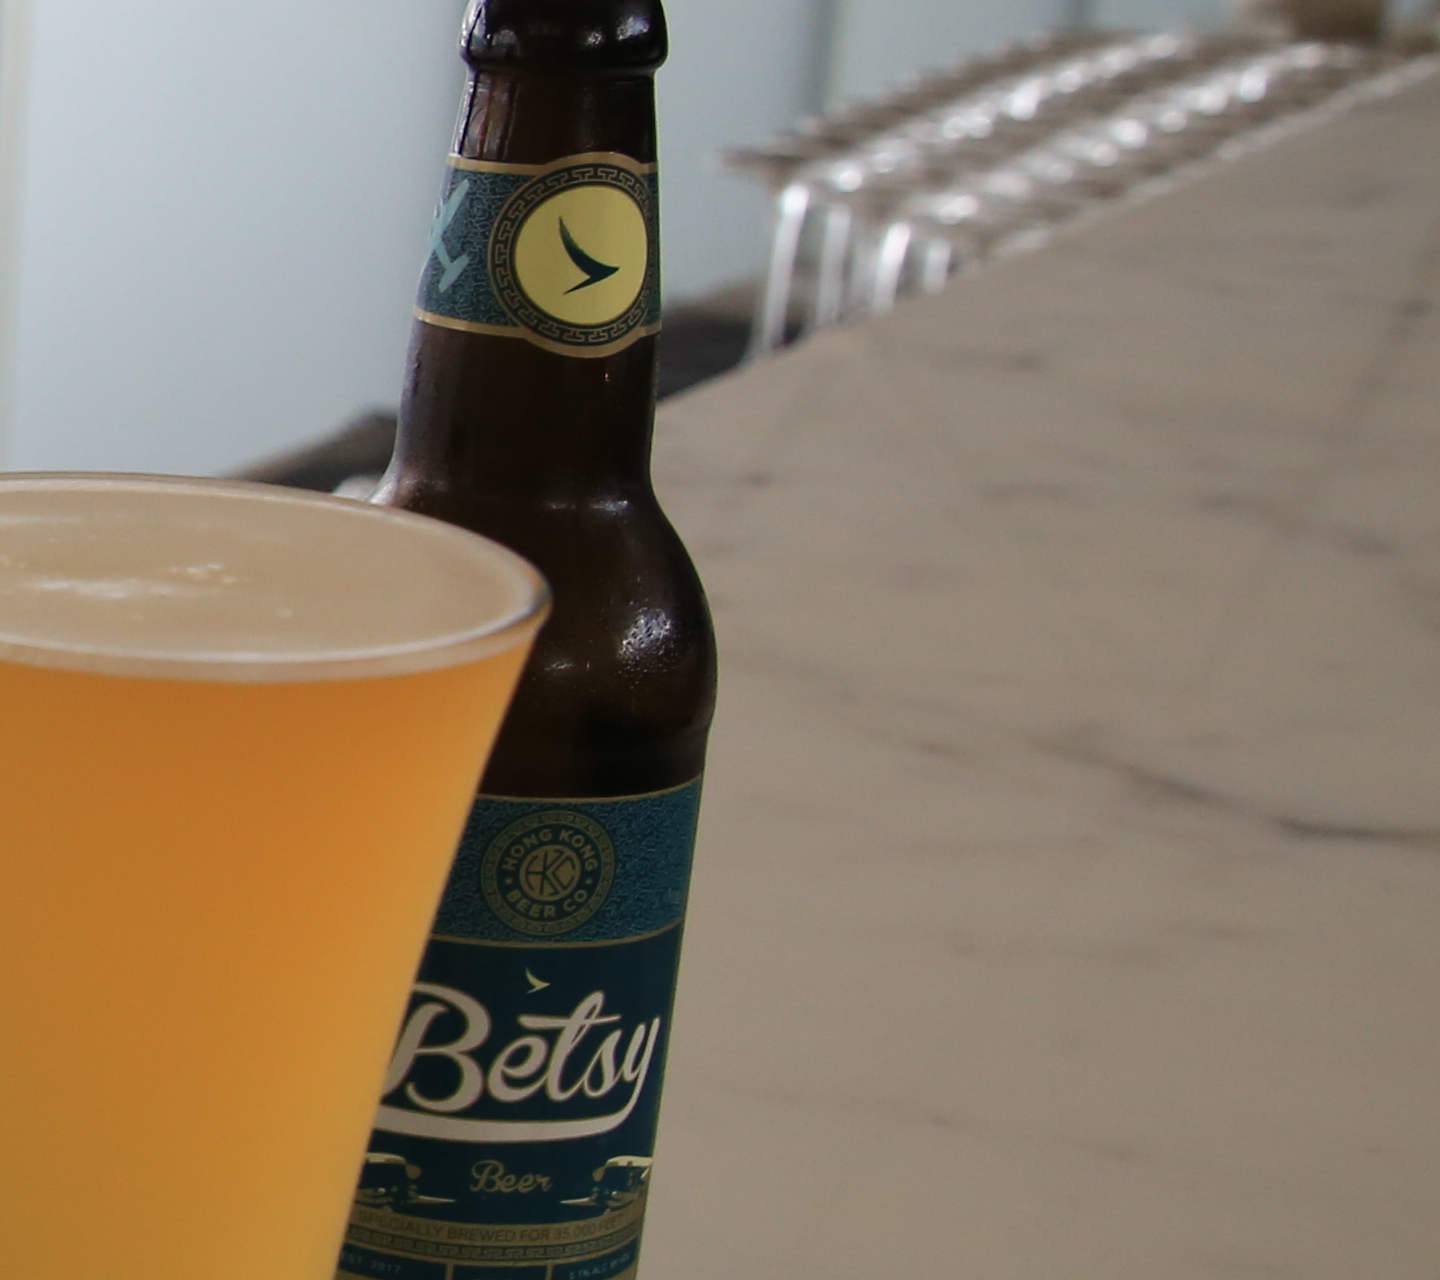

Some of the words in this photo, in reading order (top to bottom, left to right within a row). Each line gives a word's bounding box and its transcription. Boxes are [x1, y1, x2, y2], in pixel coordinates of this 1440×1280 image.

[501, 828, 552, 871] HONG
[559, 828, 599, 871] KONG
[506, 888, 556, 918] BEER
[562, 889, 589, 912] CO
[370, 981, 660, 1143] Betsy
[469, 1158, 553, 1194] Beer
[519, 1228, 550, 1241] FOR
